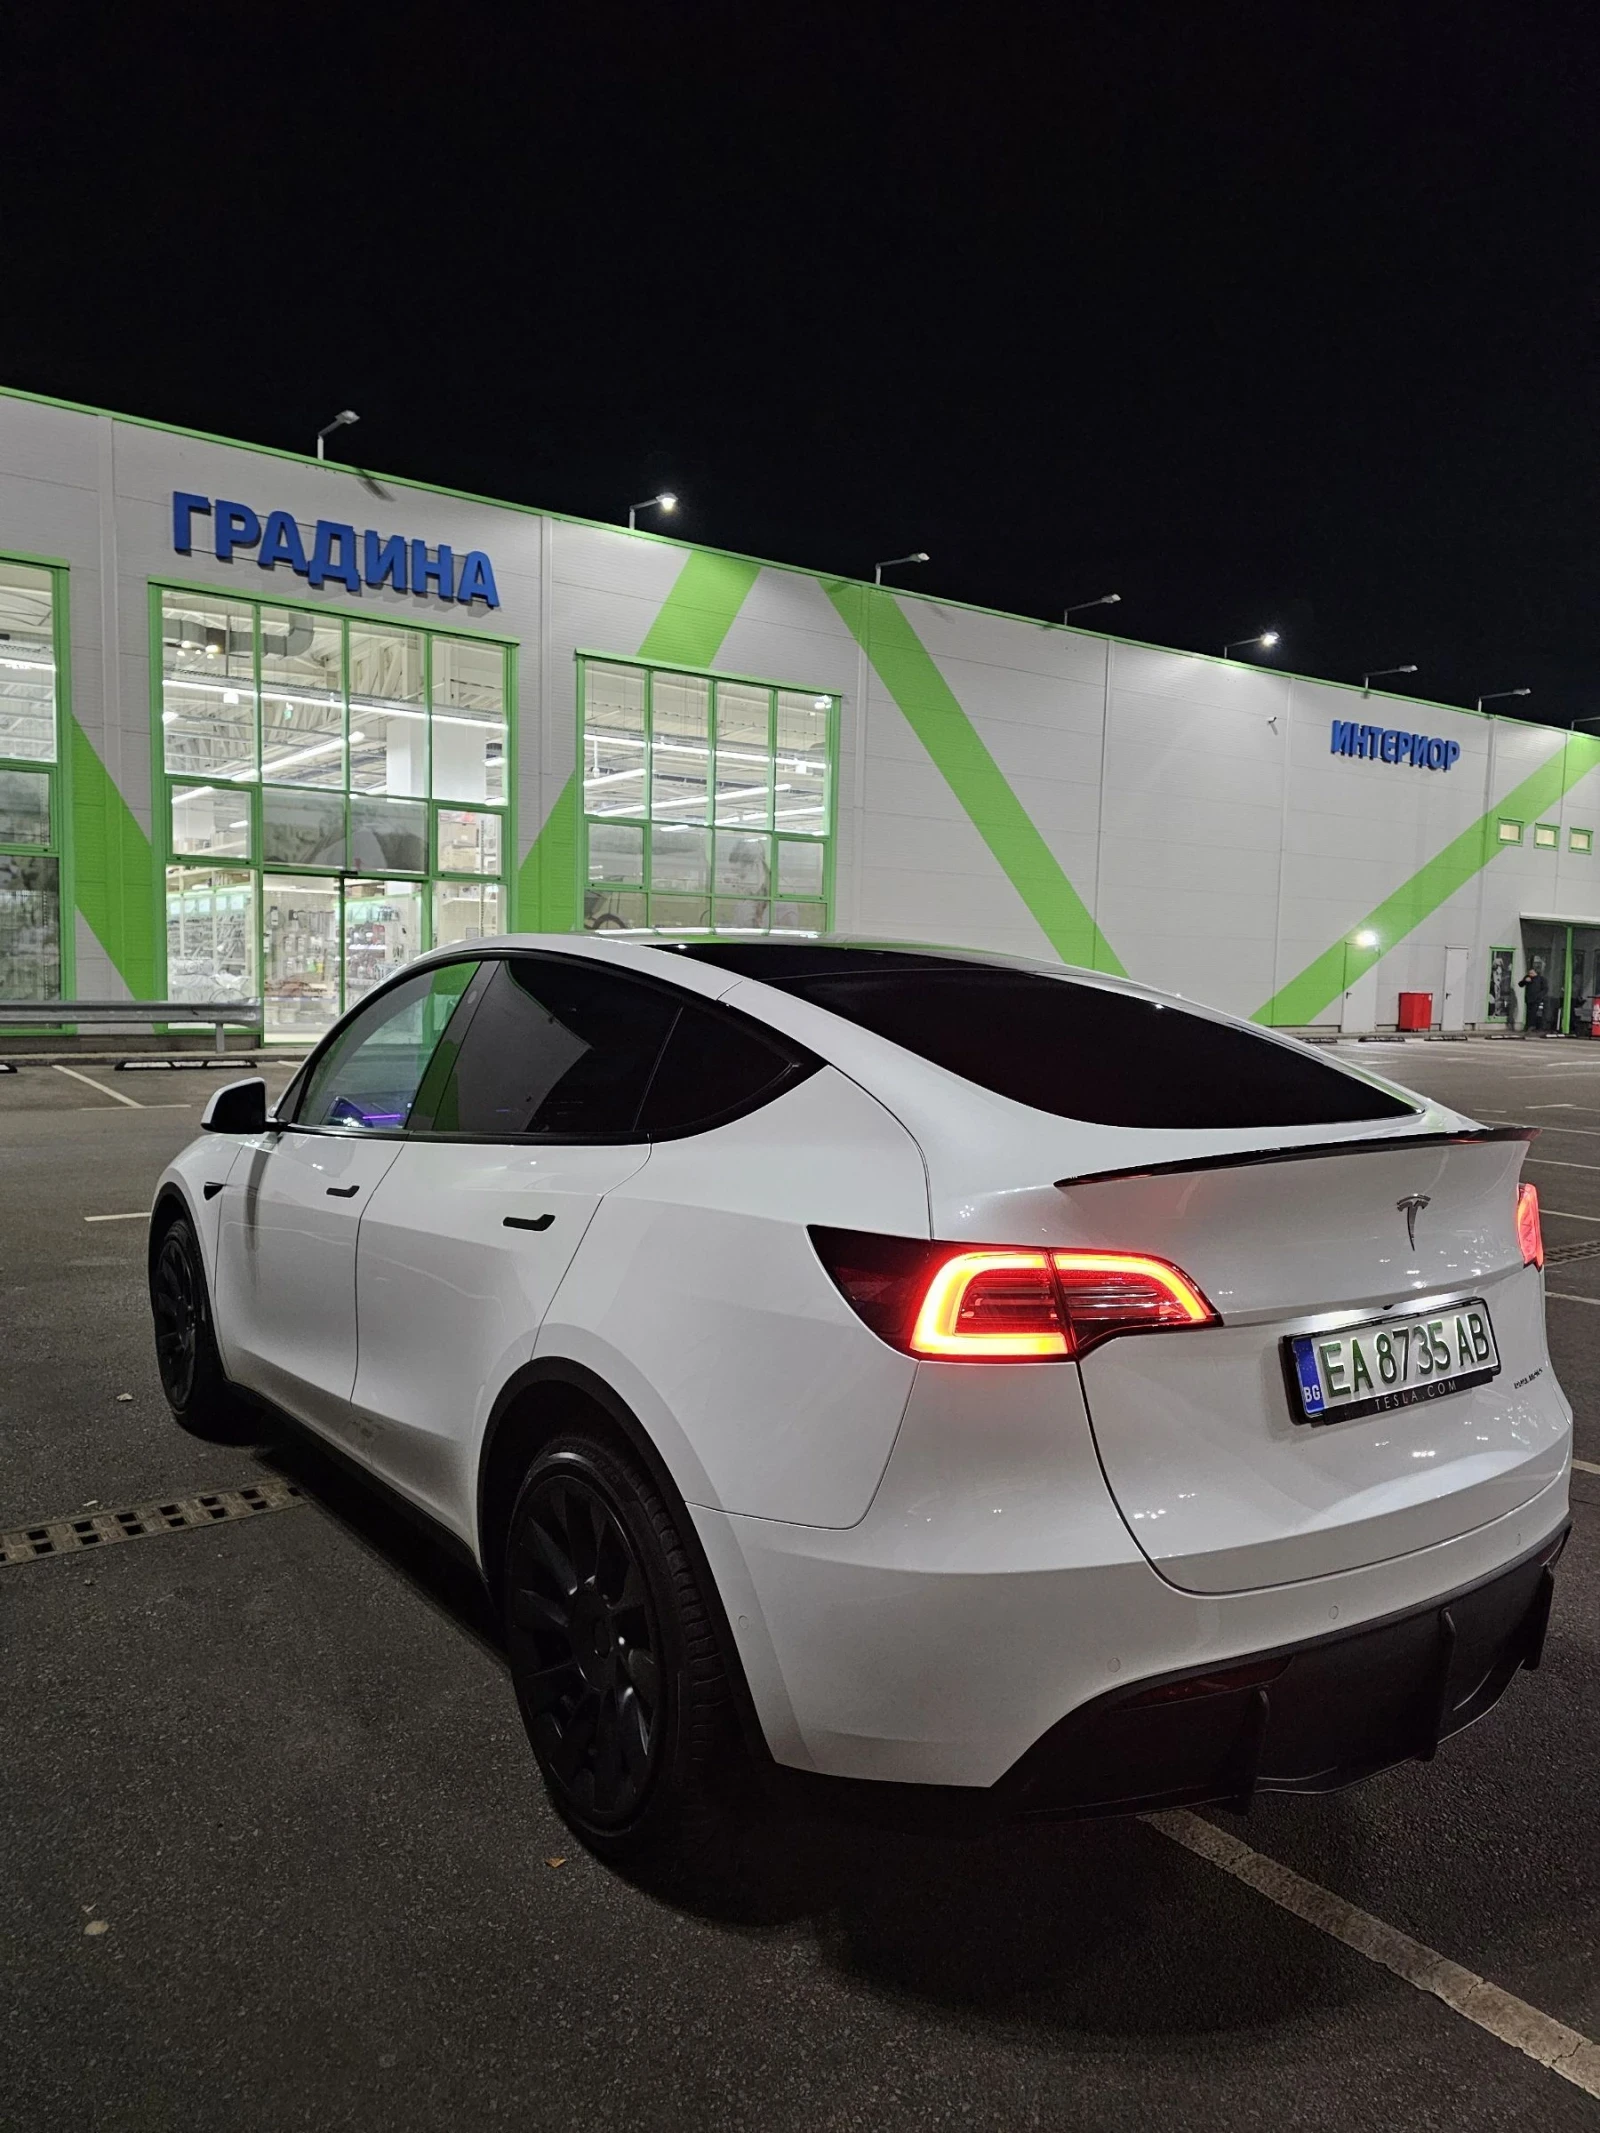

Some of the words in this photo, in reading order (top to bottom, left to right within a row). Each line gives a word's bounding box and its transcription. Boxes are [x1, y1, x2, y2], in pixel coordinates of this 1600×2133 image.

[173, 491, 499, 609] ГРАДИНА
[1331, 720, 1460, 772] ИНТЕРИОР
[1318, 1337, 1374, 1398] EA
[1374, 1319, 1451, 1384] 8735
[1454, 1313, 1490, 1367] AB
[1303, 1385, 1321, 1403] BG
[1375, 1380, 1457, 1411] TESLA.COM
